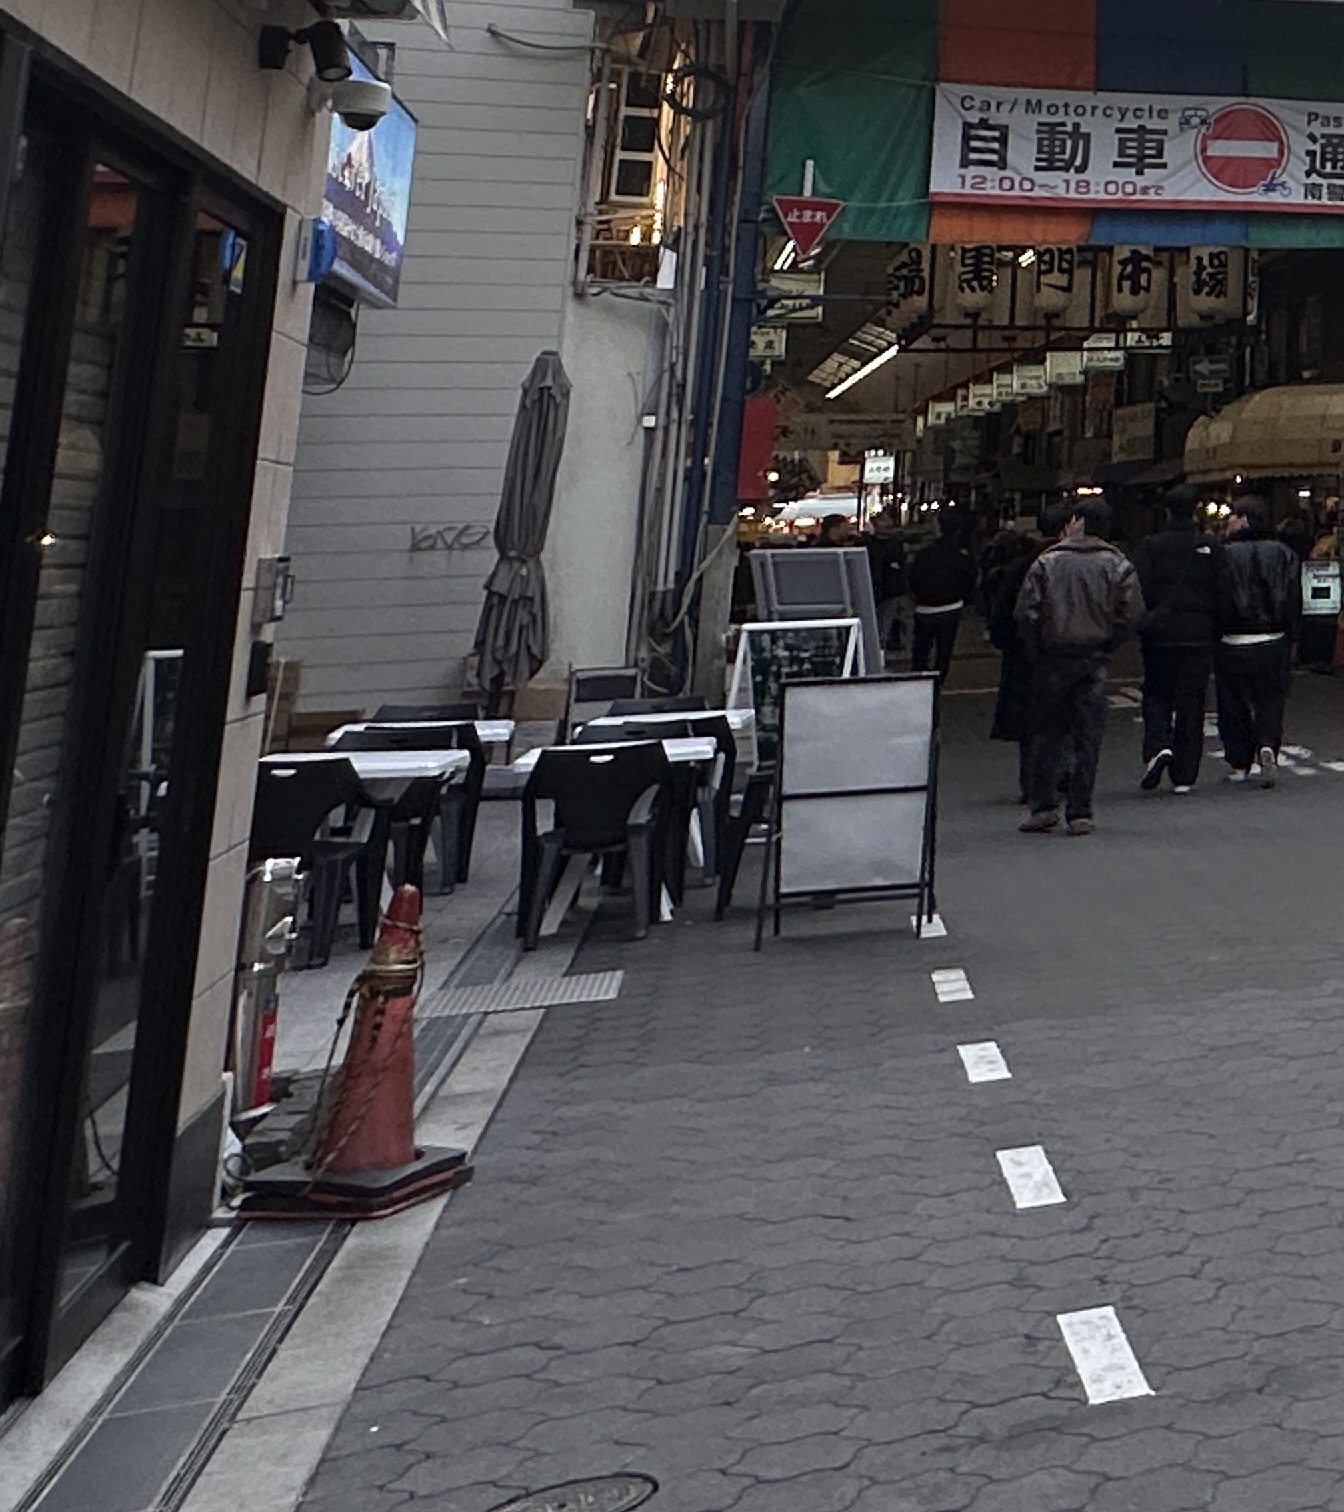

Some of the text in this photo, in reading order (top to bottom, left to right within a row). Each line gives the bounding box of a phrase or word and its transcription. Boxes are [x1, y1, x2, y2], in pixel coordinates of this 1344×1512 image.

[960, 94, 1170, 122] Car/Motorcycle
[959, 116, 1169, 176] 自動車
[786, 208, 829, 224] 止まれ
[957, 245, 1229, 300] 黒門市場
